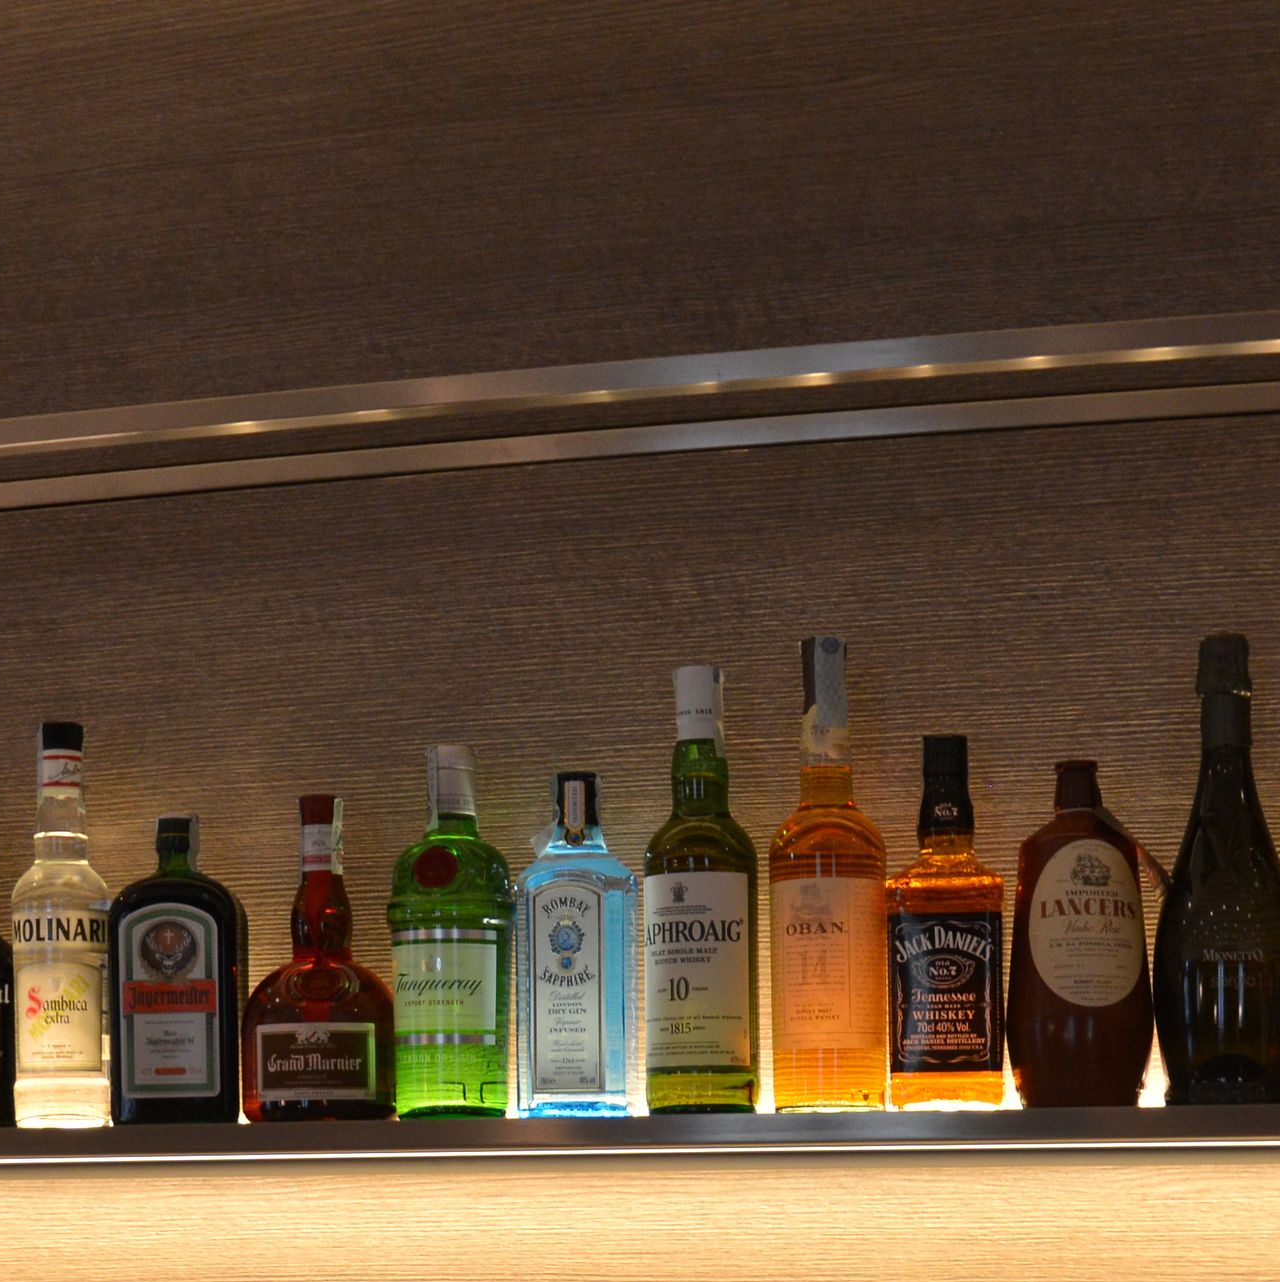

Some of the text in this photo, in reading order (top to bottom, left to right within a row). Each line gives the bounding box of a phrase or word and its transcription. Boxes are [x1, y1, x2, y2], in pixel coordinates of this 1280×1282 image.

[1065, 889, 1119, 897] IMPORTED
[542, 896, 591, 919] BOMBAY
[1040, 897, 1138, 919] LANCERS
[13, 917, 106, 943] MOLINARI
[644, 919, 742, 946] APHROAIG
[667, 947, 694, 956] SINGLE
[895, 925, 994, 963] JACK DANIEL'S
[655, 957, 678, 965] SCOTCH
[396, 972, 483, 997] Tanqueray
[540, 964, 594, 988] SAPPHIRE
[668, 976, 690, 1001] 10
[911, 988, 977, 1003] Tennessee
[26, 984, 89, 1019] Sambuca
[428, 999, 464, 1007] STRENGTH
[44, 1012, 71, 1025] extra
[911, 1010, 976, 1020] WHISKEY
[669, 1022, 692, 1035] 1815
[916, 1021, 936, 1033] 70cl
[936, 1021, 955, 1032] 40%
[267, 1052, 363, 1073] Grand Marnier
